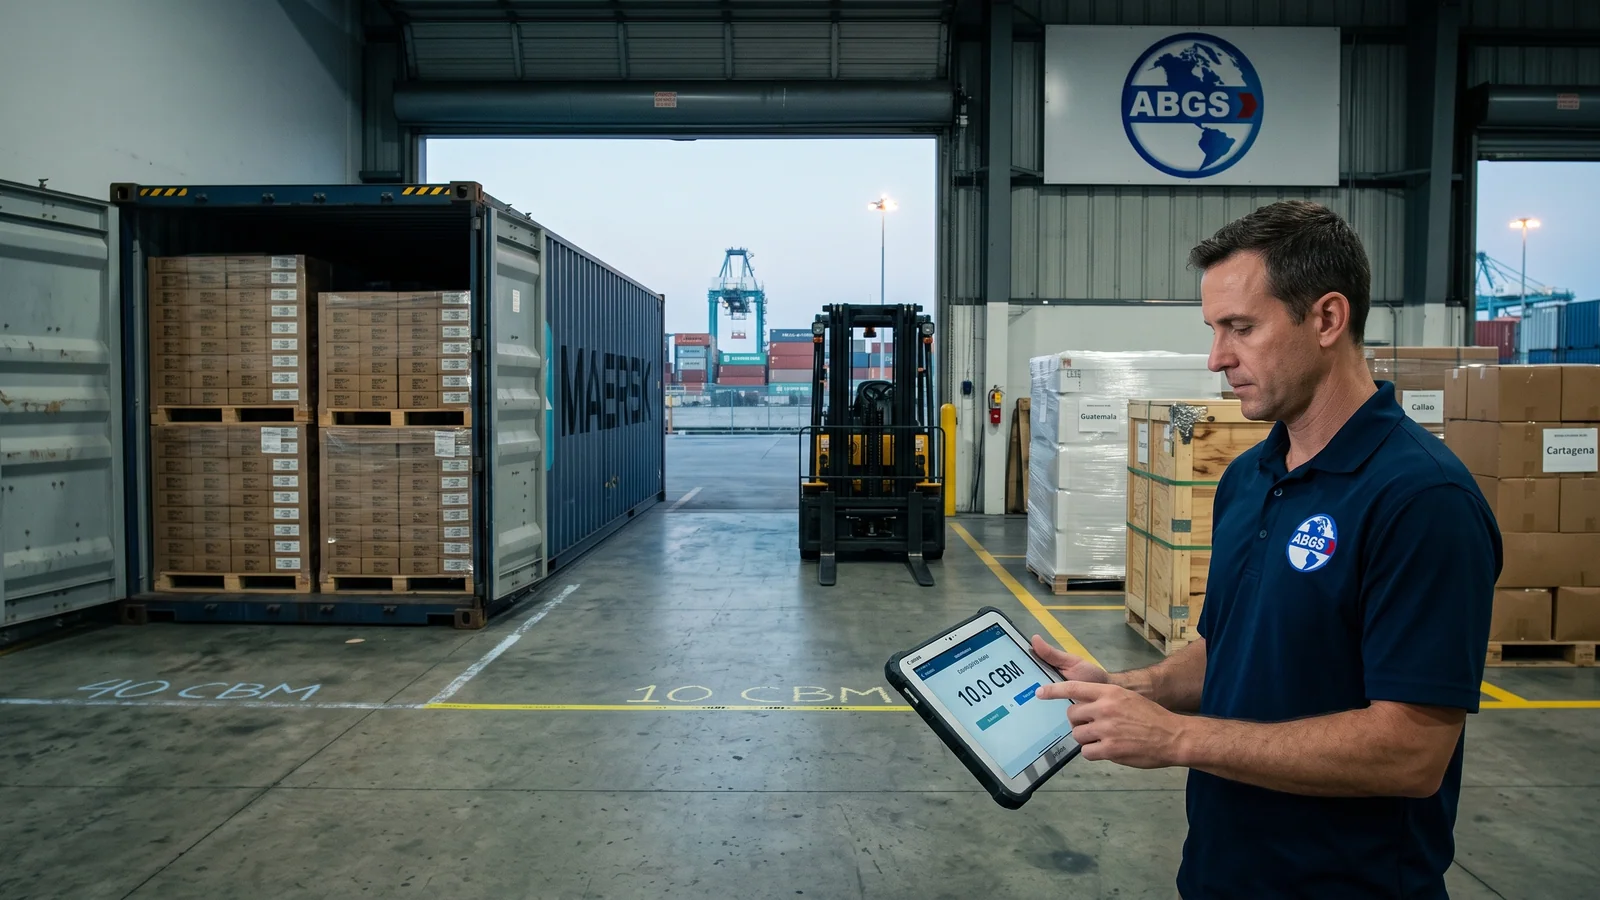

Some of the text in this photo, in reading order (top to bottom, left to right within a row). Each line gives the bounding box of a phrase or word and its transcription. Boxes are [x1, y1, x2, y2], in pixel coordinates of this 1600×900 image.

[1129, 90, 1230, 118] ABGS
[561, 345, 652, 437] MAERSK
[1411, 403, 1435, 411] Callao
[1546, 446, 1595, 457] Cartagena
[1291, 532, 1326, 551] ABGS
[77, 678, 322, 701] 40 CBM
[958, 679, 993, 707] 10.0
[988, 660, 1025, 688] CBM
[626, 685, 893, 704] 10 CBM
